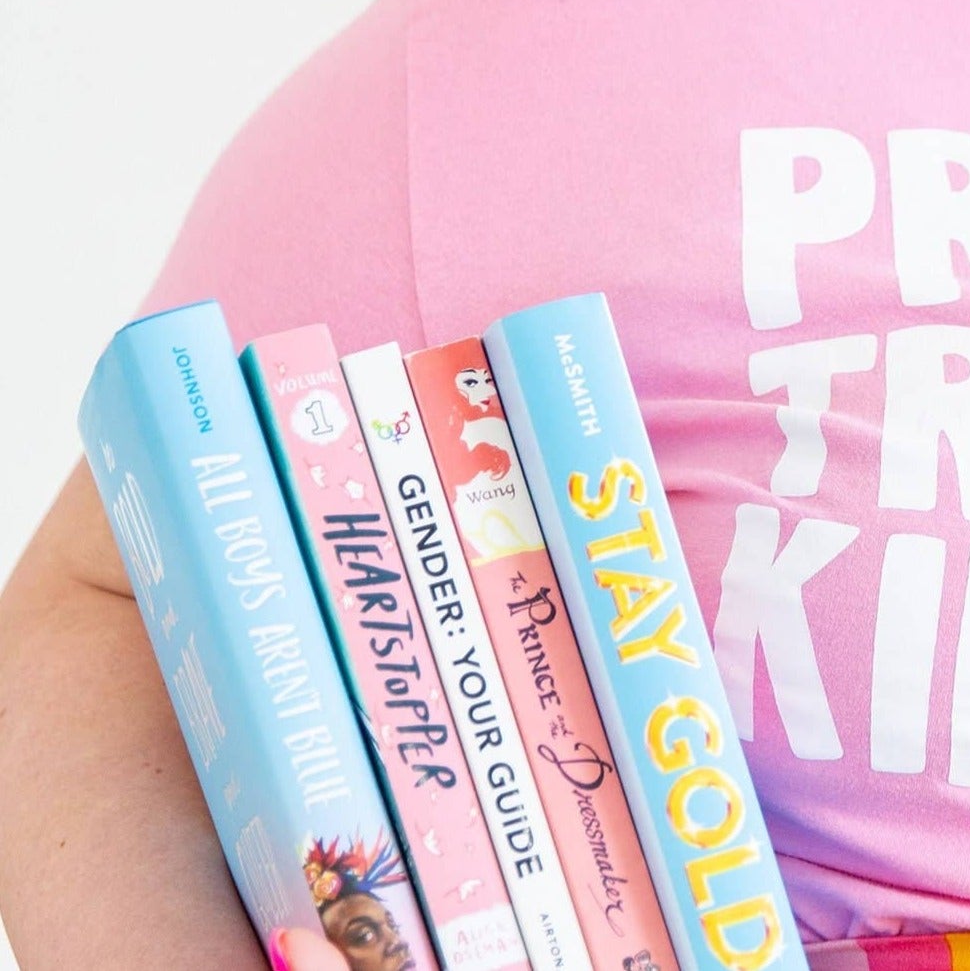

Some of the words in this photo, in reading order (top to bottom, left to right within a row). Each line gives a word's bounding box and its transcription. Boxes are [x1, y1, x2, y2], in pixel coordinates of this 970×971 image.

[172, 346, 213, 434] JOHNSON
[305, 399, 334, 436] 1
[555, 333, 602, 437] McSMITH
[190, 453, 253, 515] ALL
[466, 483, 516, 504] Wang
[215, 516, 287, 612] BOYS
[398, 473, 467, 638] GENDER:
[452, 647, 503, 752] YOUR
[487, 762, 543, 879] GUIDE
[506, 586, 562, 711] PRINCE
[557, 714, 575, 737] and
[569, 459, 698, 666] STAY
[645, 696, 782, 971] GOLD
[282, 724, 352, 814] BLUE
[537, 742, 629, 938] Dressmaker
[539, 912, 564, 968] AIRTON
